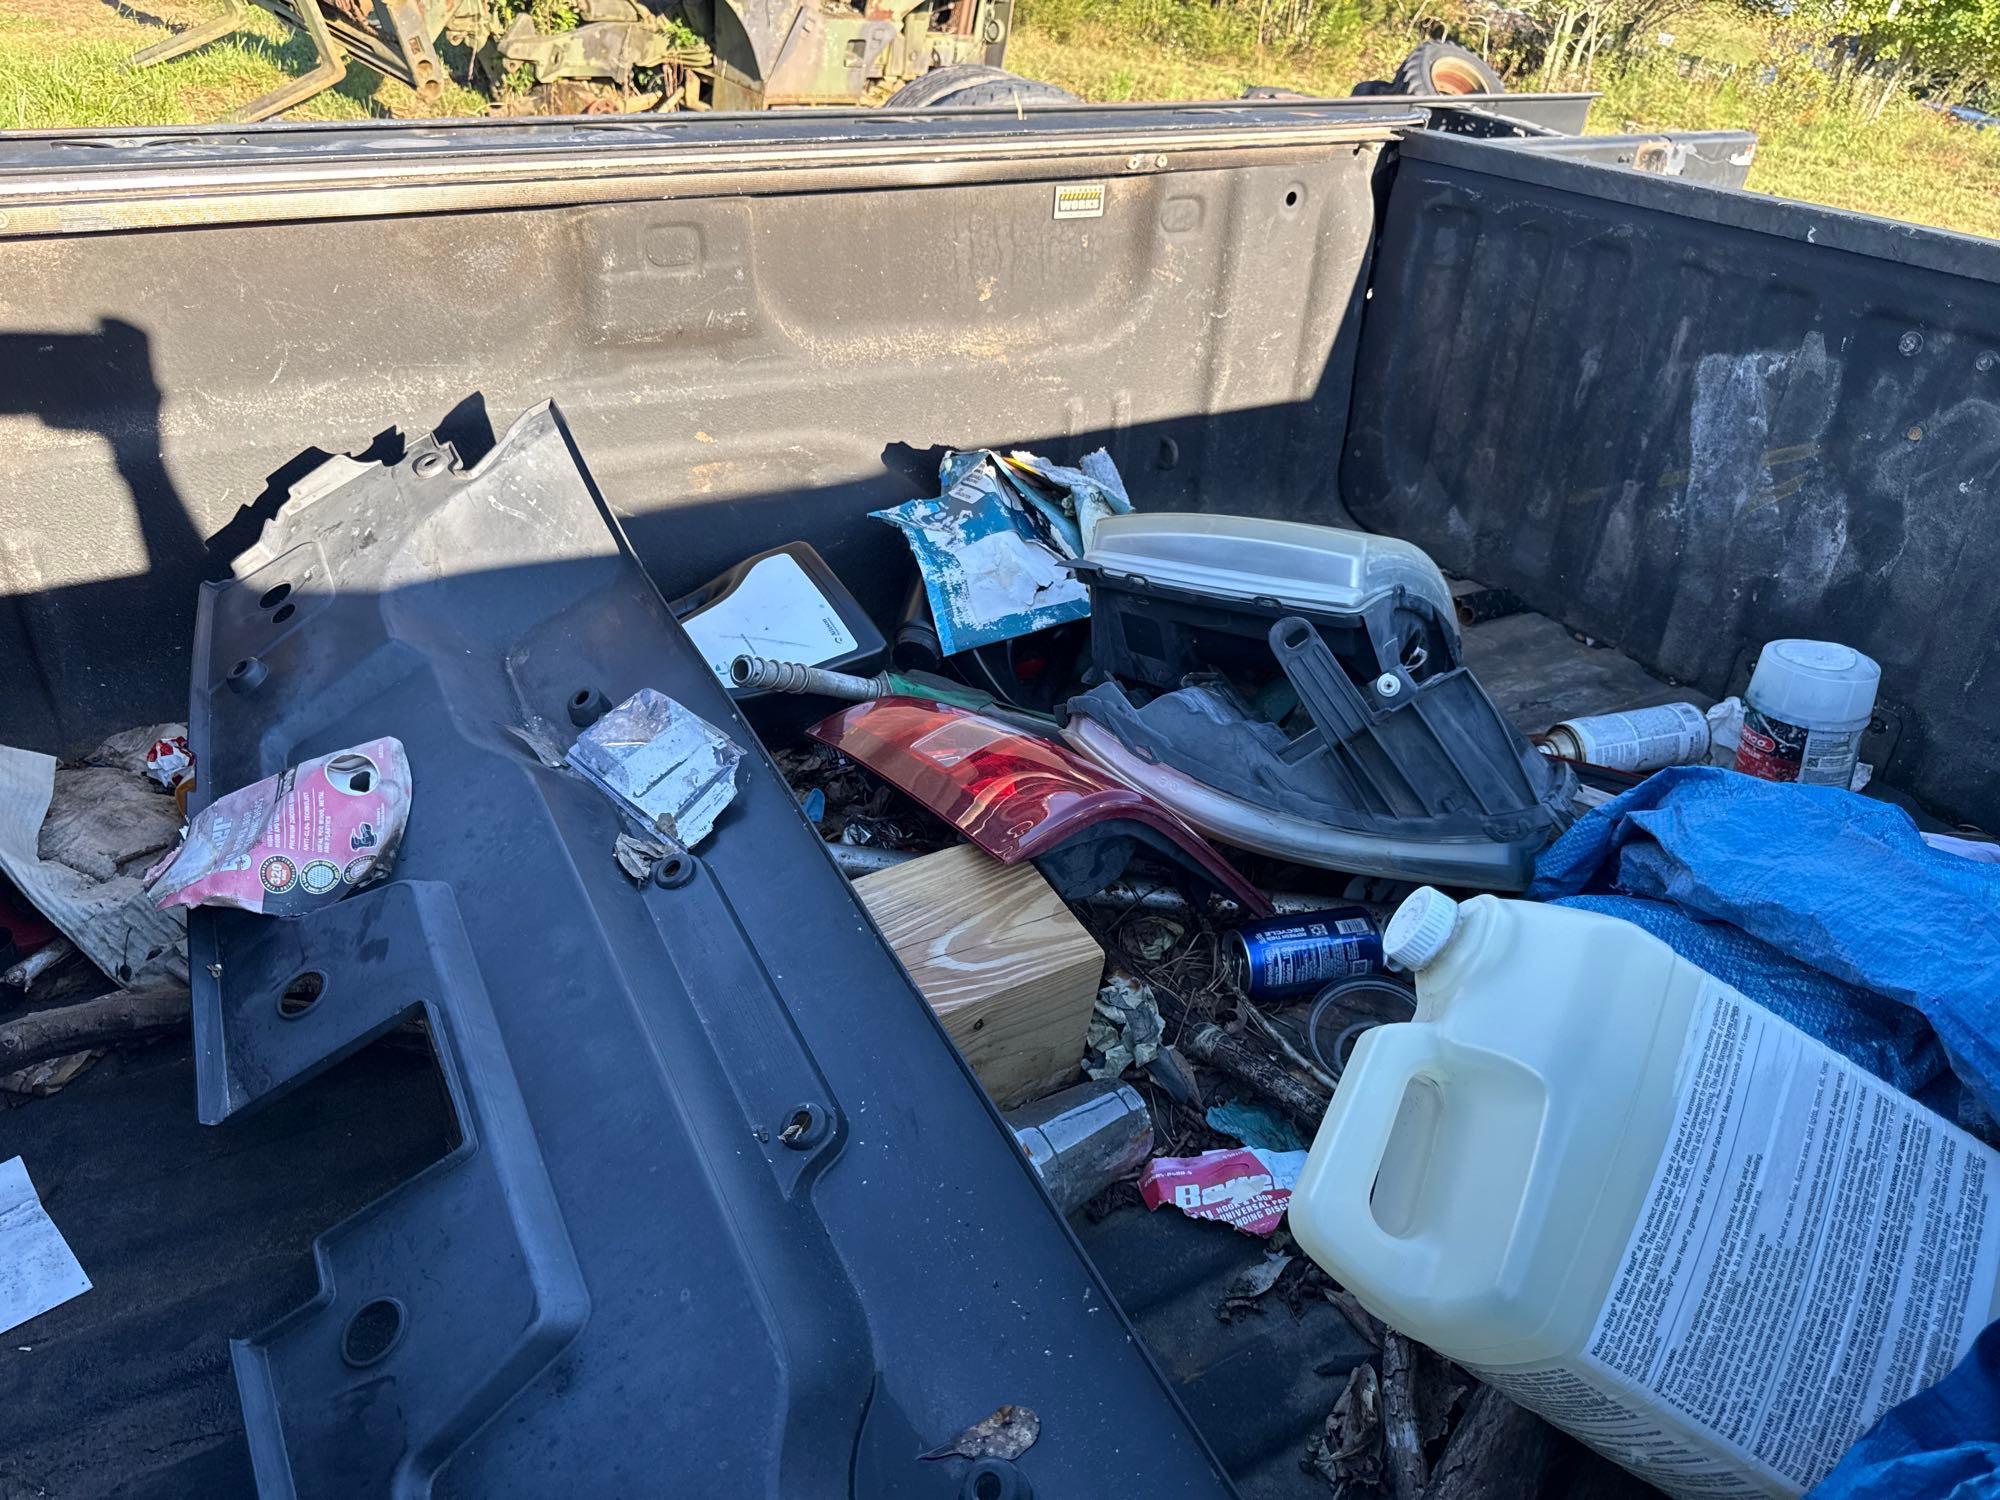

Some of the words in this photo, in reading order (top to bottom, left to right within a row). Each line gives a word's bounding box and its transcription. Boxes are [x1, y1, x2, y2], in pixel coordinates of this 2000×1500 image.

[1060, 198, 1100, 211] WORKS
[270, 863, 280, 884] 320
[1264, 927, 1304, 936] RECYCLE
[1679, 1129, 1685, 1137] of
[1672, 1137, 1682, 1155] place
[1935, 1134, 1949, 1168] California
[1945, 1139, 1956, 1166] defects
[1670, 1155, 1676, 1163] in
[1705, 1149, 1718, 1176] degrees
[1896, 1152, 1902, 1163] OF
[1665, 1163, 1673, 1176] use
[1740, 1166, 1749, 1181] and
[1888, 1163, 1901, 1194] SOURCES
[1934, 1167, 1941, 1177] of
[1941, 1166, 1951, 1184] birth
[1662, 1176, 1668, 1184] to
[1701, 1174, 1709, 1188] 140
[1930, 1177, 1940, 1198] State
[1653, 1184, 1665, 1207] choice
[1696, 1188, 1705, 1204] than
[1733, 1180, 1746, 1204] fueling
[1743, 1182, 1754, 1204] before
[1937, 1184, 1948, 1206] cause
[1216, 1203, 1238, 1214] HOOK
[1252, 1194, 1272, 1203] LOOP
[1220, 1202, 1271, 1220] UNIVERSAL
[1265, 1203, 1289, 1216] DISC
[1730, 1203, 1738, 1214] for
[1883, 1195, 1894, 1218] OTHER
[1927, 1196, 1936, 1211] the
[1936, 1206, 1943, 1215] to
[1644, 1207, 1657, 1232] perfect
[1688, 1204, 1701, 1229] greater
[1735, 1203, 1747, 1231] minutes
[1927, 1210, 1933, 1219] to
[1685, 1228, 1692, 1236] is
[1720, 1214, 1735, 1247] directions
[1880, 1218, 1888, 1233] ALL
[1920, 1219, 1932, 1246] known
[1927, 1215, 1942, 1250] California
[1639, 1231, 1647, 1243] the
[1732, 1230, 1738, 1240] 15
[1876, 1233, 1884, 1249] AND
[1726, 1241, 1735, 1258] least
[1919, 1245, 1926, 1254] is
[1926, 1249, 1934, 1259] of
[1670, 1255, 1682, 1276] Klean
[1723, 1258, 1730, 1266] at
[1869, 1249, 1880, 1274] FLAME
[1886, 1263, 1894, 1274] OF
[1912, 1254, 1924, 1278] which
[1921, 1259, 1932, 1280] State
[1614, 1277, 1629, 1302] Klean
[1714, 1277, 1723, 1293] cool
[1861, 1275, 1874, 1306] SPARKS,
[1878, 1274, 1891, 1305] BUILDUP
[1909, 1278, 1918, 1296] soot
[1918, 1280, 1927, 1294] the
[1711, 1292, 1718, 1301] to
[1916, 1294, 1924, 1303] to
[1690, 1298, 1706, 1332] appliance
[1704, 1301, 1715, 1320] allow
[1855, 1307, 1866, 1329] HEAT,
[1900, 1296, 1915, 1326] contain
[1909, 1304, 1922, 1331] known
[1922, 1309, 1930, 1319] to
[1651, 1317, 1659, 1326] of
[1698, 1320, 1708, 1334] and
[1811, 1305, 1831, 1354] SWALLOWED.
[1868, 1305, 1883, 1338] PREVENT
[1920, 1319, 1928, 1331] go
[1644, 1325, 1656, 1345] point
[1685, 1331, 1694, 1344] the
[1848, 1329, 1859, 1351] FROM
[1866, 1338, 1873, 1348] TO
[1907, 1331, 1914, 1339] is
[1637, 1344, 1649, 1362] flash
[1676, 1343, 1689, 1365] follow
[1685, 1334, 1703, 1369] appliance
[1808, 1354, 1815, 1362] IF
[1887, 1326, 1907, 1374] by-products
[1900, 1339, 1912, 1364] which
[1906, 1330, 1925, 1375] information
[1653, 1346, 1677, 1394] DIRECTIONS:
[1841, 1352, 1852, 1375] AWAY
[1665, 1365, 1681, 1392] Always
[1680, 1368, 1689, 1379] off
[1800, 1361, 1812, 1385] FATAL
[1851, 1349, 1870, 1397] VENTILATION
[1884, 1374, 1892, 1385] its
[1673, 1378, 1685, 1396] Turn
[1796, 1385, 1804, 1397] OR
[1834, 1375, 1844, 1395] KEEP
[1900, 1375, 1912, 1398] more
[1661, 1391, 1668, 1399] 1.
[1668, 1396, 1676, 1405] 2.
[1879, 1386, 1889, 1403] and
[1783, 1397, 1800, 1434] HARMFUL
[1838, 1398, 1855, 1438] ADEQUATE
[1752, 1409, 1776, 1458] IMPORTANT:
[1830, 1438, 1842, 1459] WITH
